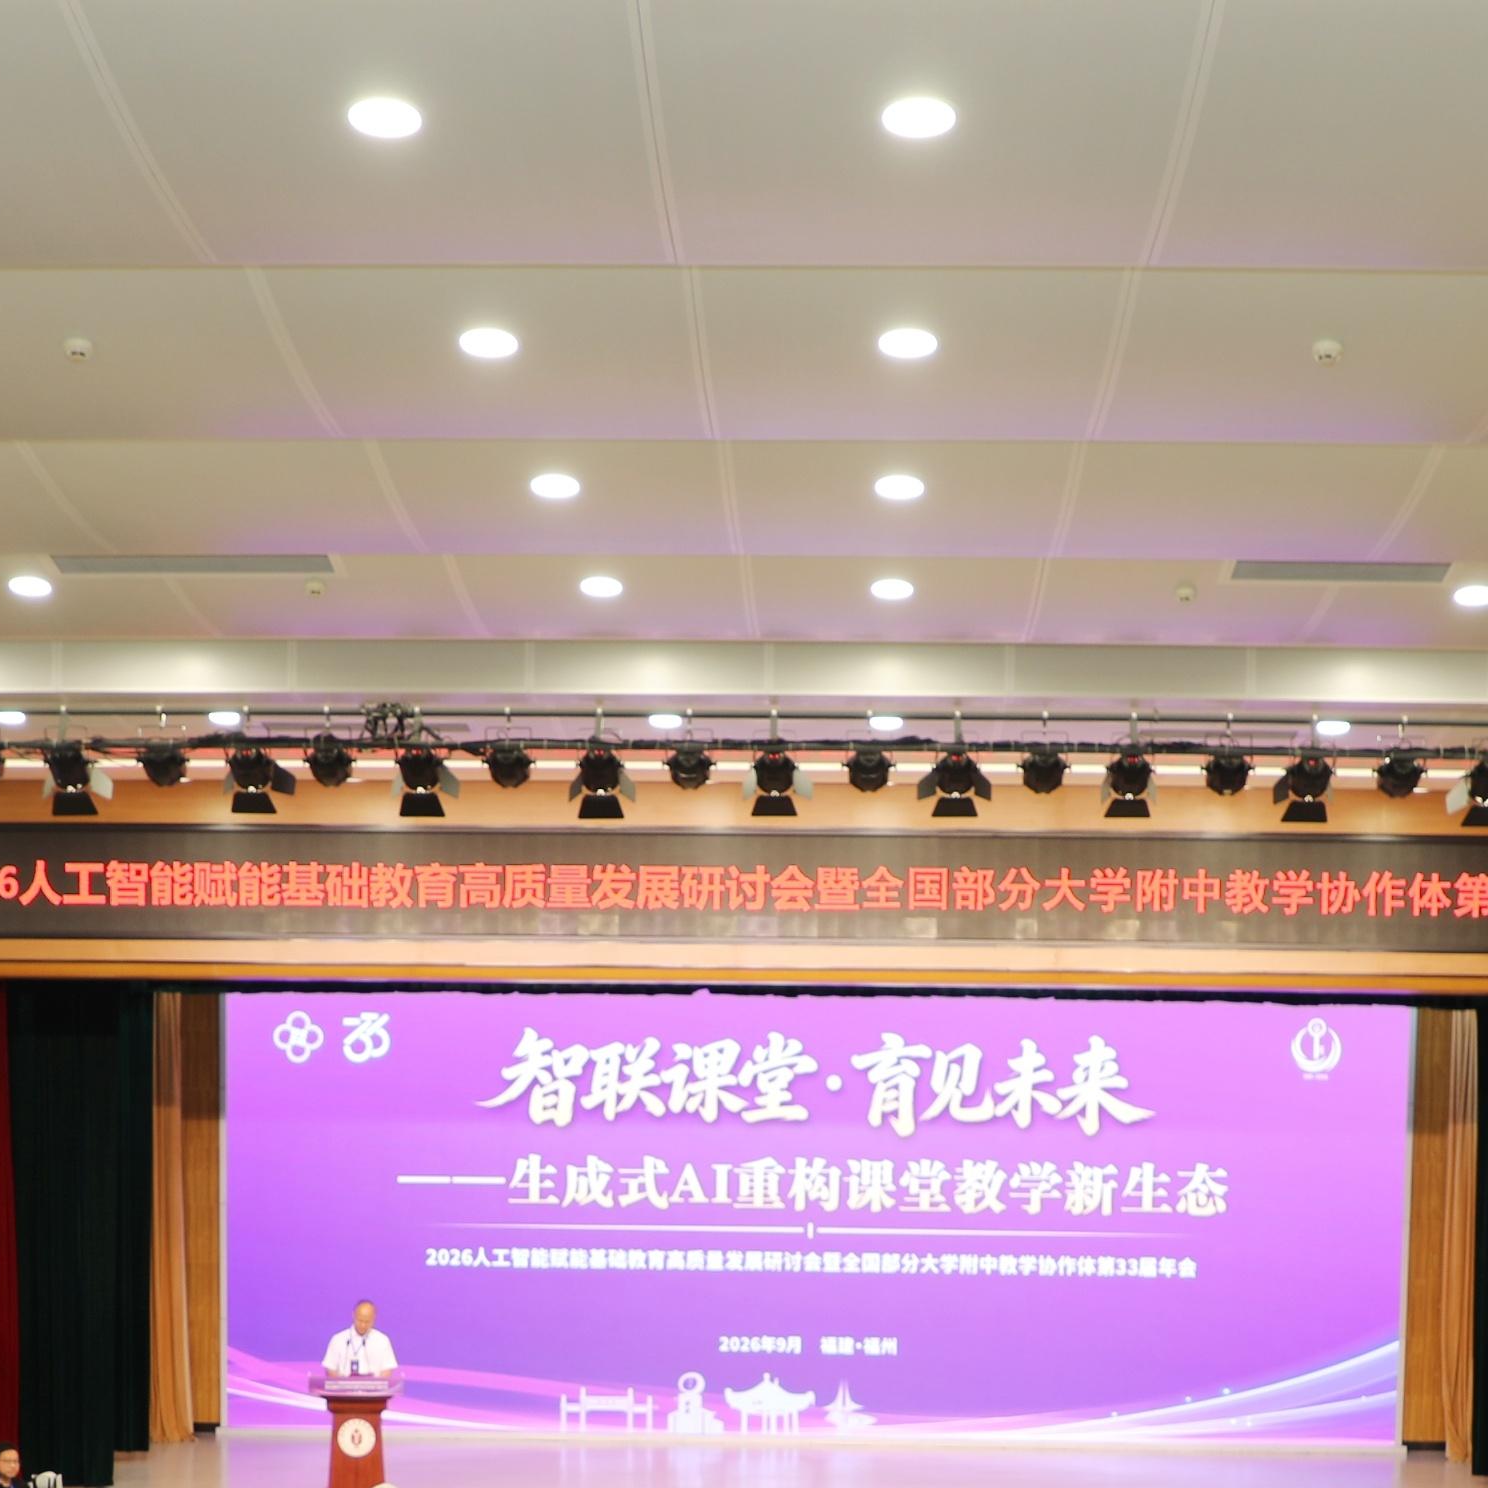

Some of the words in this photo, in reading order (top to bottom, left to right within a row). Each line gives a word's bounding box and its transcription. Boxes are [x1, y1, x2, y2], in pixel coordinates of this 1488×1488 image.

[478, 1027, 1156, 1138] 智联课堂·育见未来
[718, 1335, 803, 1355] 2026年9月
